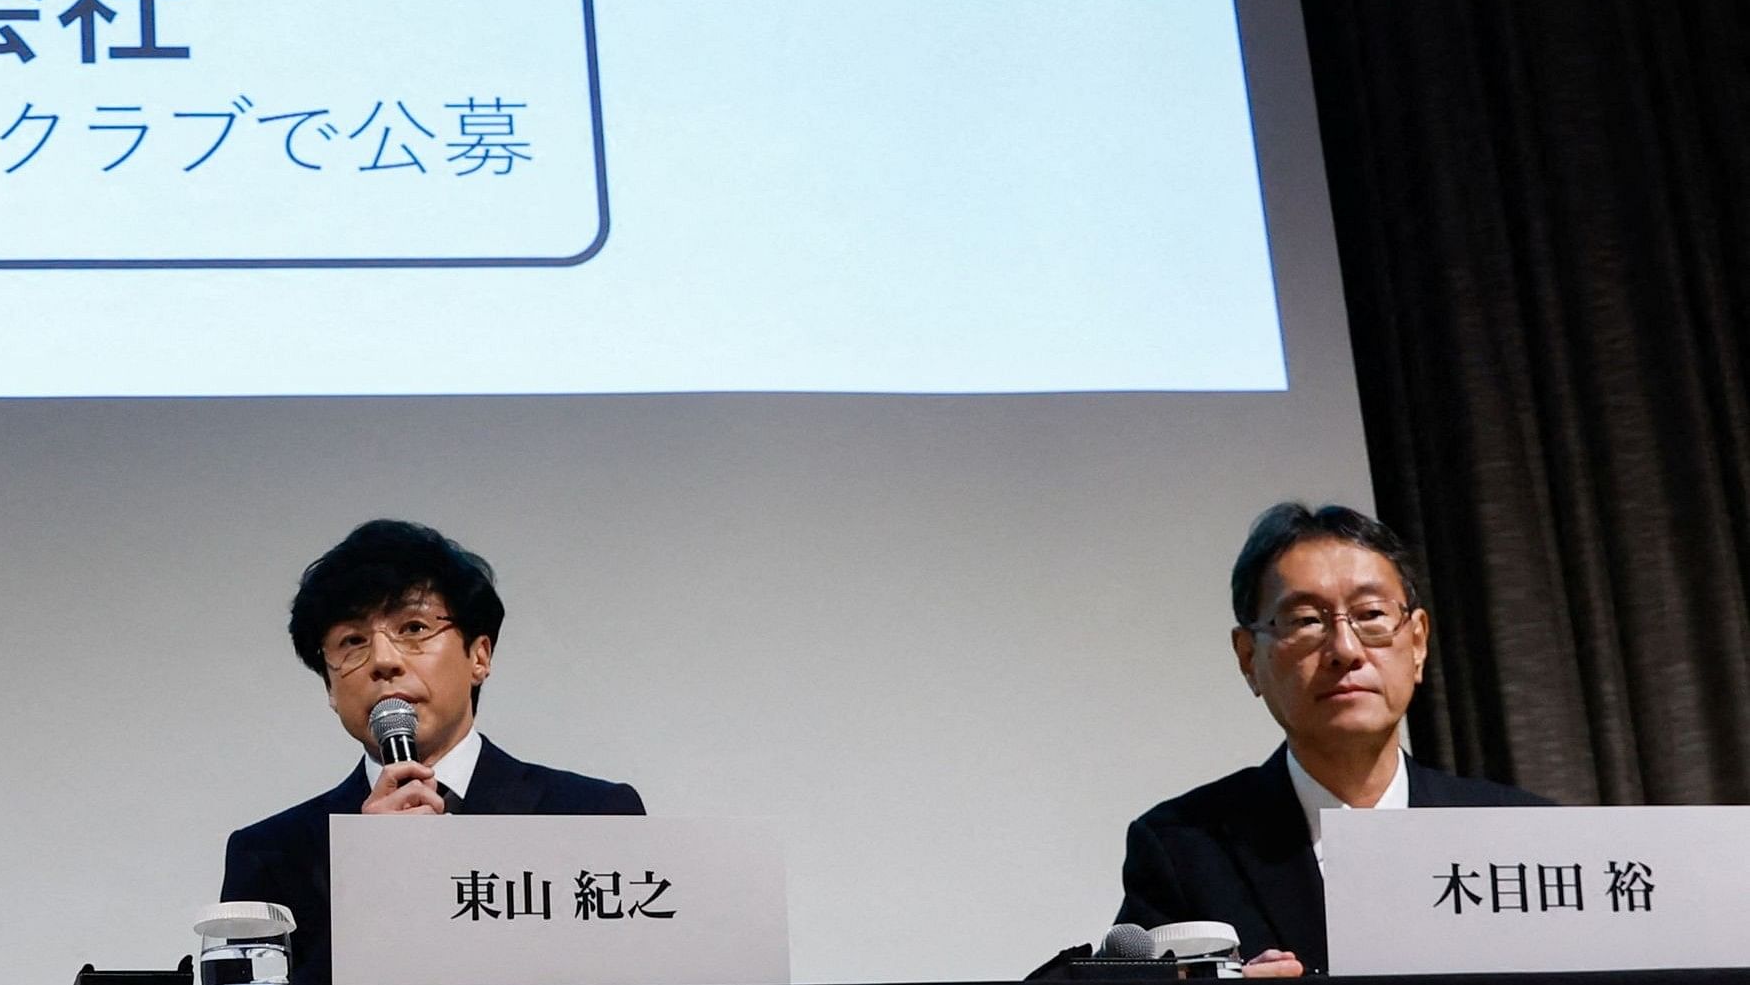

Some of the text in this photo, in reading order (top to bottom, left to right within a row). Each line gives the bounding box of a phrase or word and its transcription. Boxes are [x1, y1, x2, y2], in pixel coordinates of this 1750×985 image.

[450, 869, 678, 922] 東山 紀之
[1432, 860, 1656, 915] 木目田 裕
